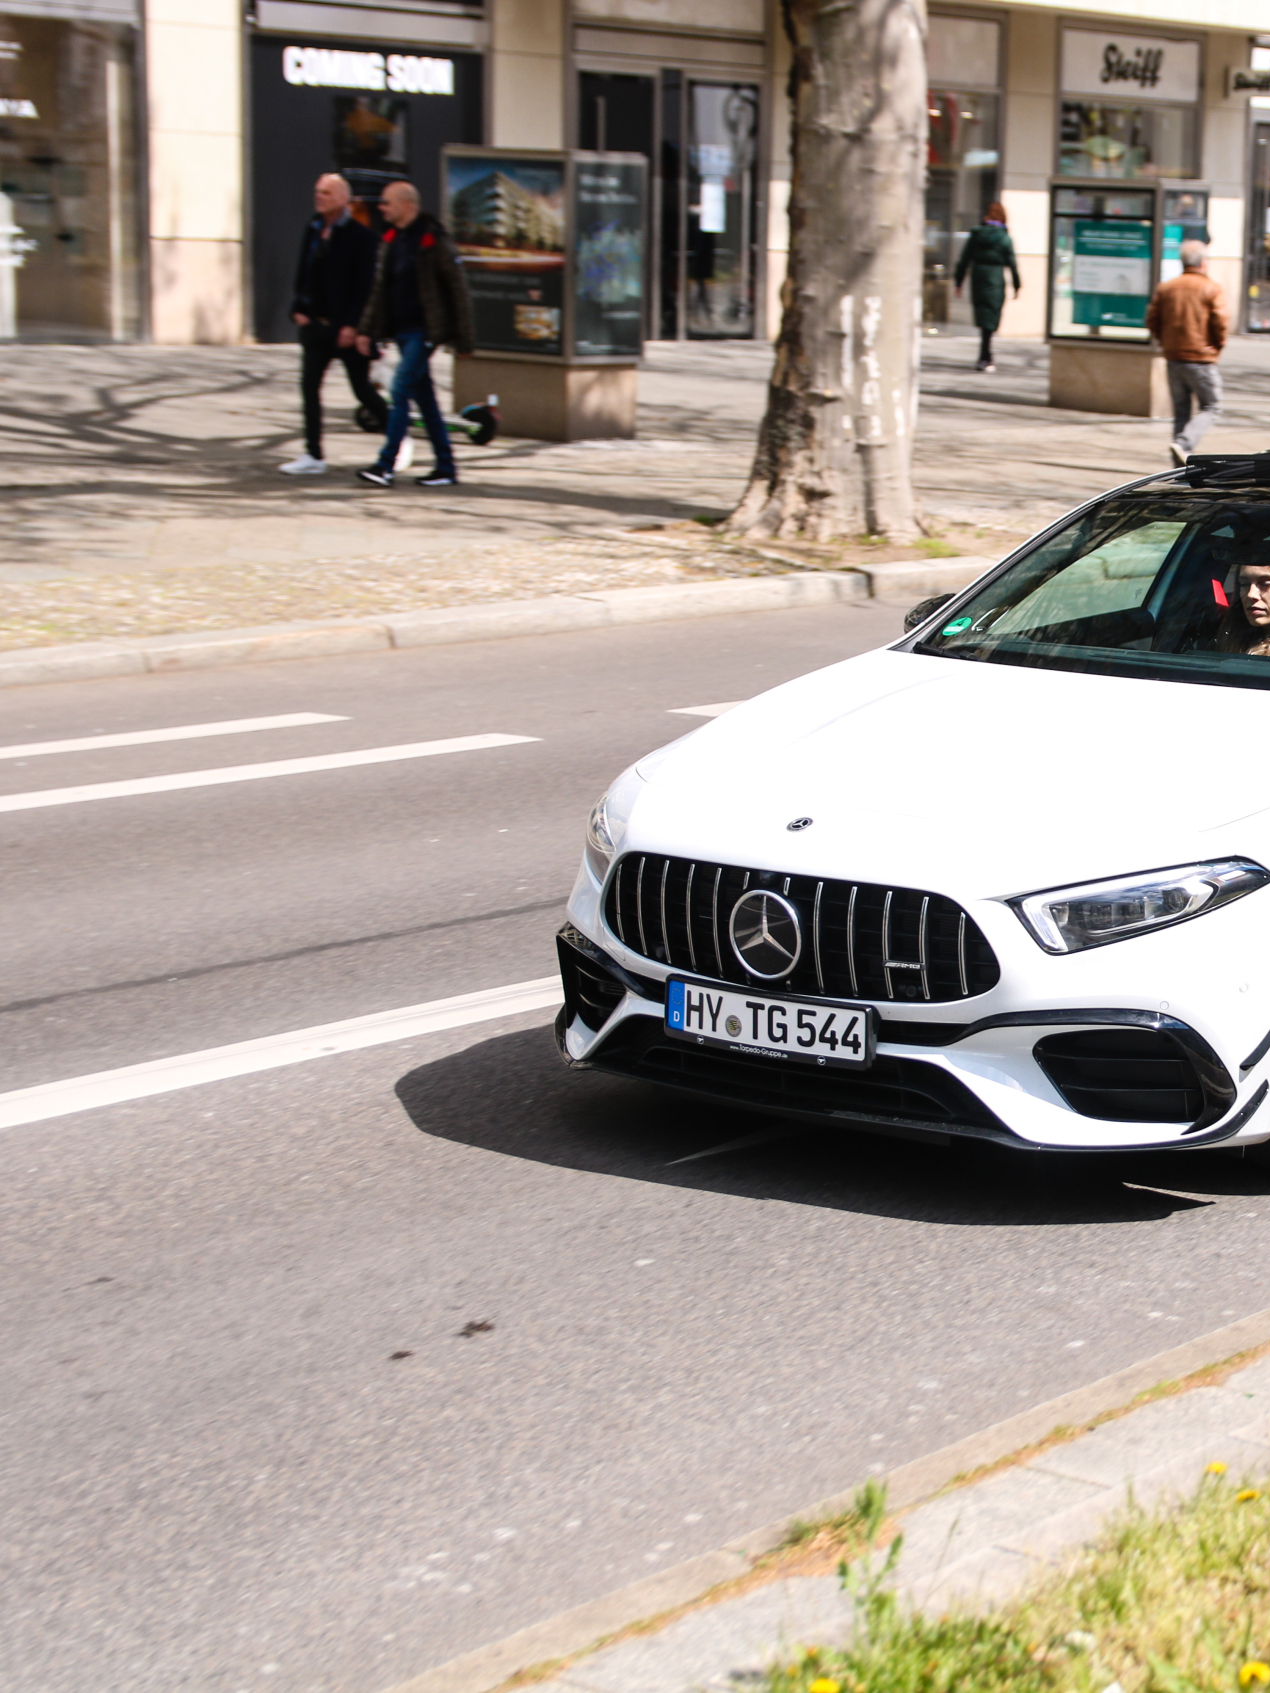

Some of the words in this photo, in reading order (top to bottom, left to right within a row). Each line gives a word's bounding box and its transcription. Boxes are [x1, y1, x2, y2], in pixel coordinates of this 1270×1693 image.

[283, 46, 387, 90] COMING
[387, 54, 454, 95] SOON
[1101, 43, 1164, 87] Steiff
[673, 1010, 680, 1022] D
[687, 989, 723, 1032] HY
[746, 1001, 788, 1043] TG
[797, 1009, 862, 1054] 544
